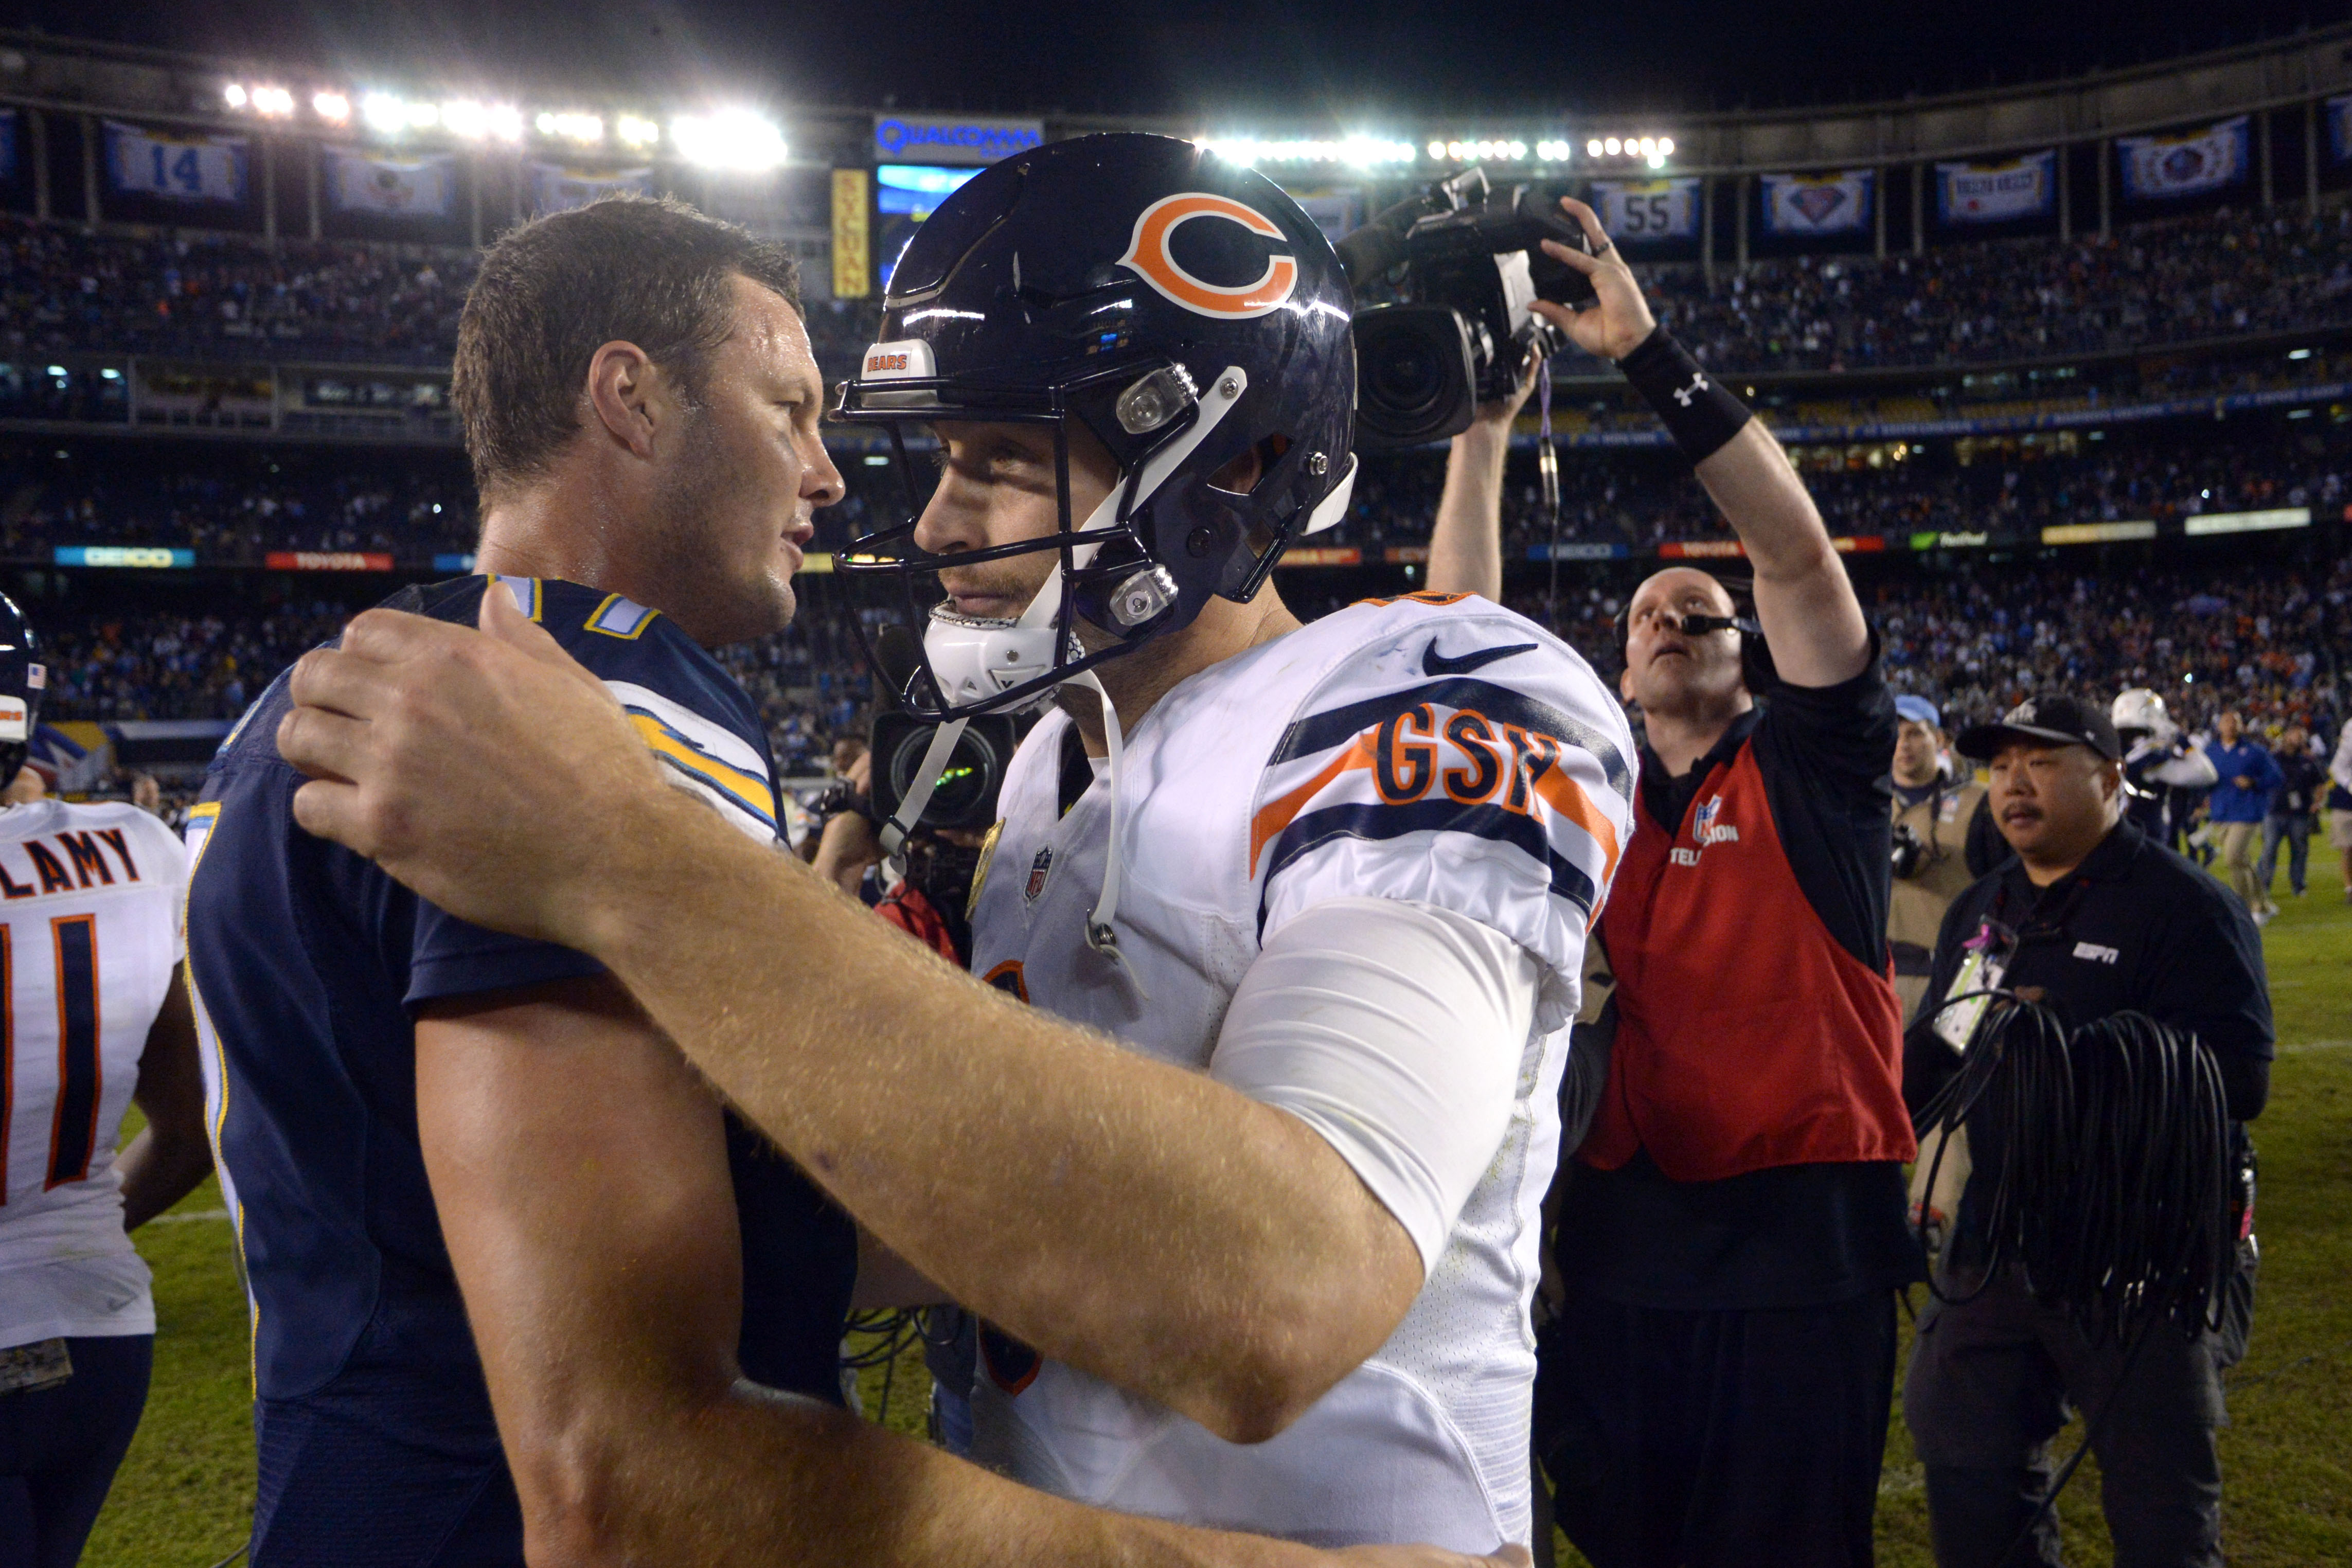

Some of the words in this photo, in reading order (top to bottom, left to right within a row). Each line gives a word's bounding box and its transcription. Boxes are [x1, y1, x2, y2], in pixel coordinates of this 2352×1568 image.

[876, 118, 1043, 156] QUALCOMM
[150, 146, 201, 191] 14
[1623, 193, 1670, 233] 55
[1115, 192, 1298, 319] C
[867, 354, 907, 372] BEARS
[84, 545, 173, 567] GEICO
[296, 551, 367, 570] TOYOTA
[2072, 941, 2119, 965] ESPN
